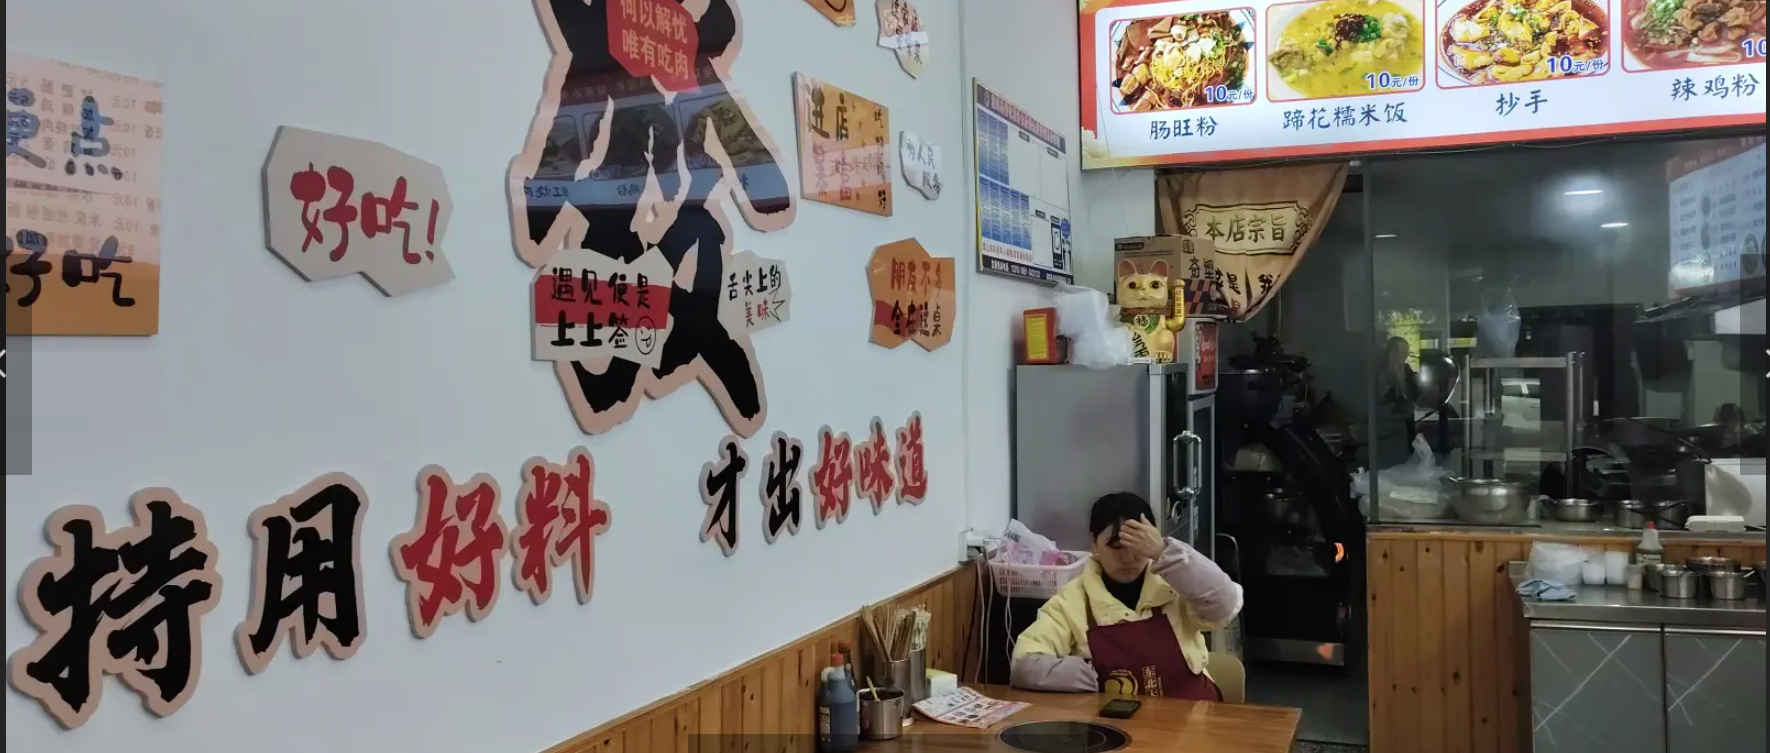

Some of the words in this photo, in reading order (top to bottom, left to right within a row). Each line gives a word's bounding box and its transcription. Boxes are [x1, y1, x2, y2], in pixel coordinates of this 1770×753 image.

[621, 29, 689, 80] 唯有吃肉
[1545, 55, 1605, 74] 10元/份
[1203, 85, 1253, 102] 10元/份
[1366, 72, 1419, 89] 10元/份
[1670, 73, 1760, 102] 辣鸡粉
[1282, 102, 1409, 131] 蹄花糯米饭
[1495, 89, 1548, 117] 抄手
[1149, 115, 1219, 140] 肠旺粉
[290, 161, 440, 265] 好吃!
[1204, 213, 1288, 243] 本店宗旨
[551, 267, 650, 309] 遇见便是
[727, 264, 782, 301] 舌尖上的
[745, 299, 771, 328] 美味
[550, 309, 630, 348] 上上签
[706, 415, 927, 549] 才出好味道
